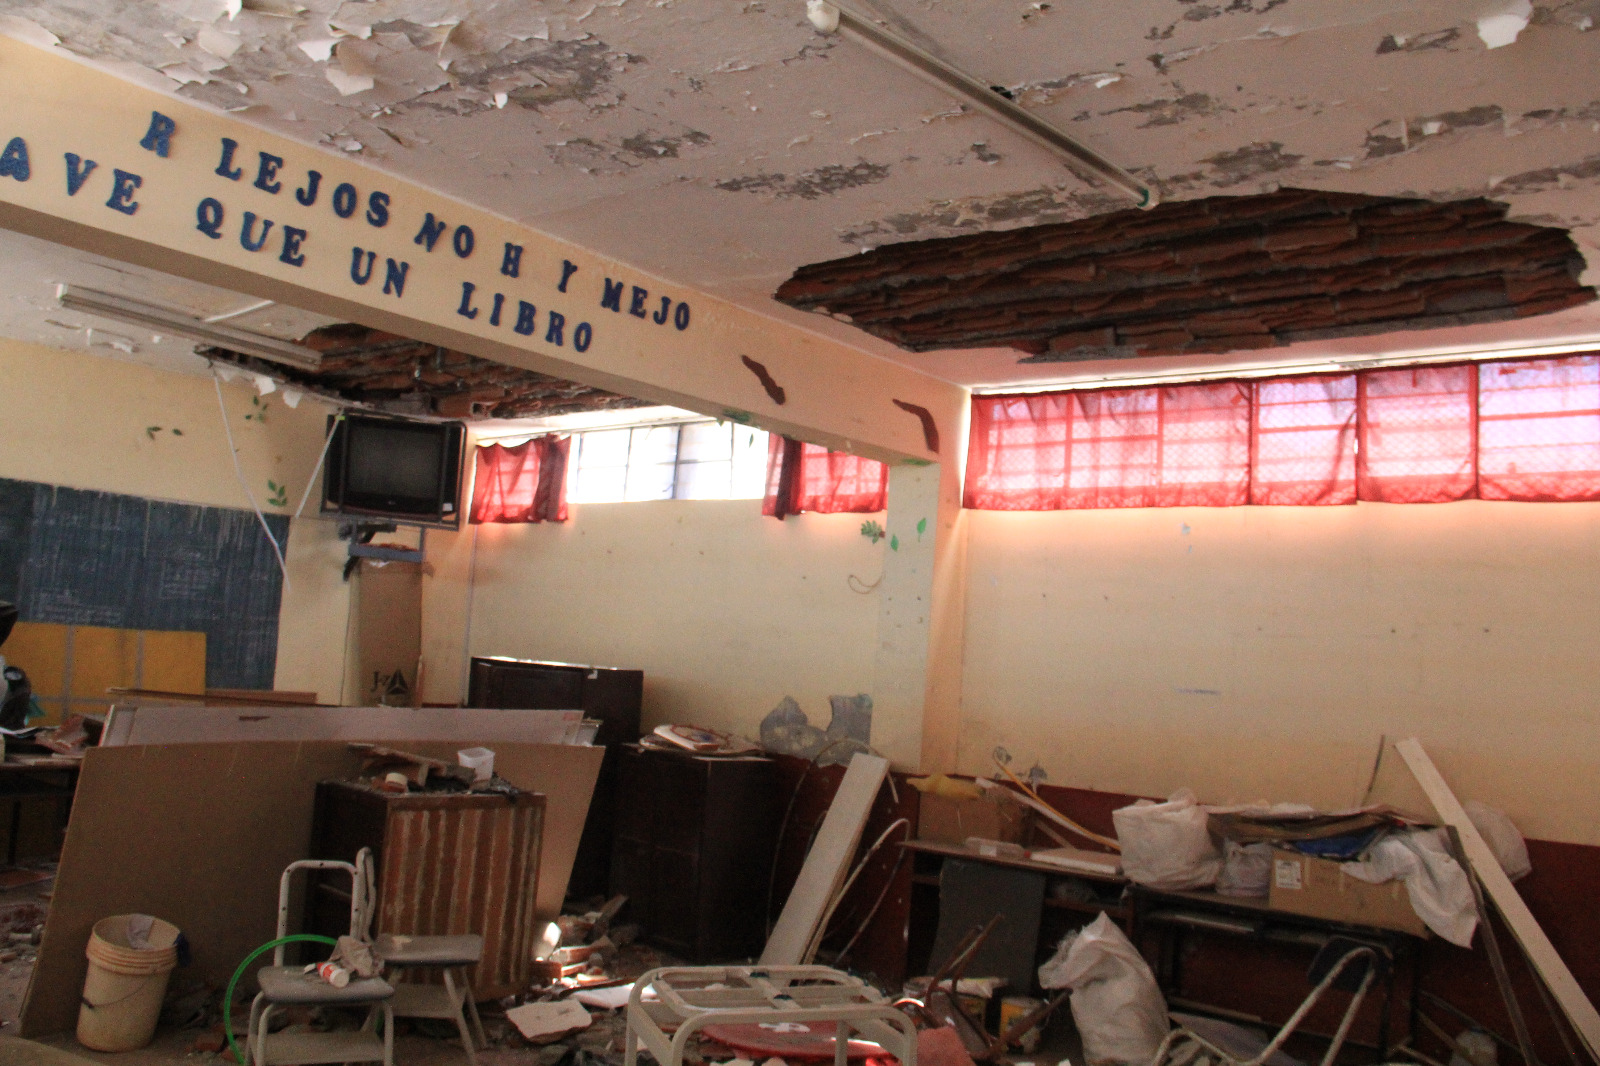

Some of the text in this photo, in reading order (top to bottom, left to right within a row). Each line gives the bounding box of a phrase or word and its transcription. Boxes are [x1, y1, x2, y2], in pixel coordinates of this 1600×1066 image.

[140, 111, 175, 157] R
[215, 138, 389, 227] LEJOS
[414, 213, 474, 258] NO
[601, 278, 689, 330] MEJO
[196, 198, 306, 267] QUE
[351, 247, 408, 297] UN
[457, 282, 592, 352] LIBRO
